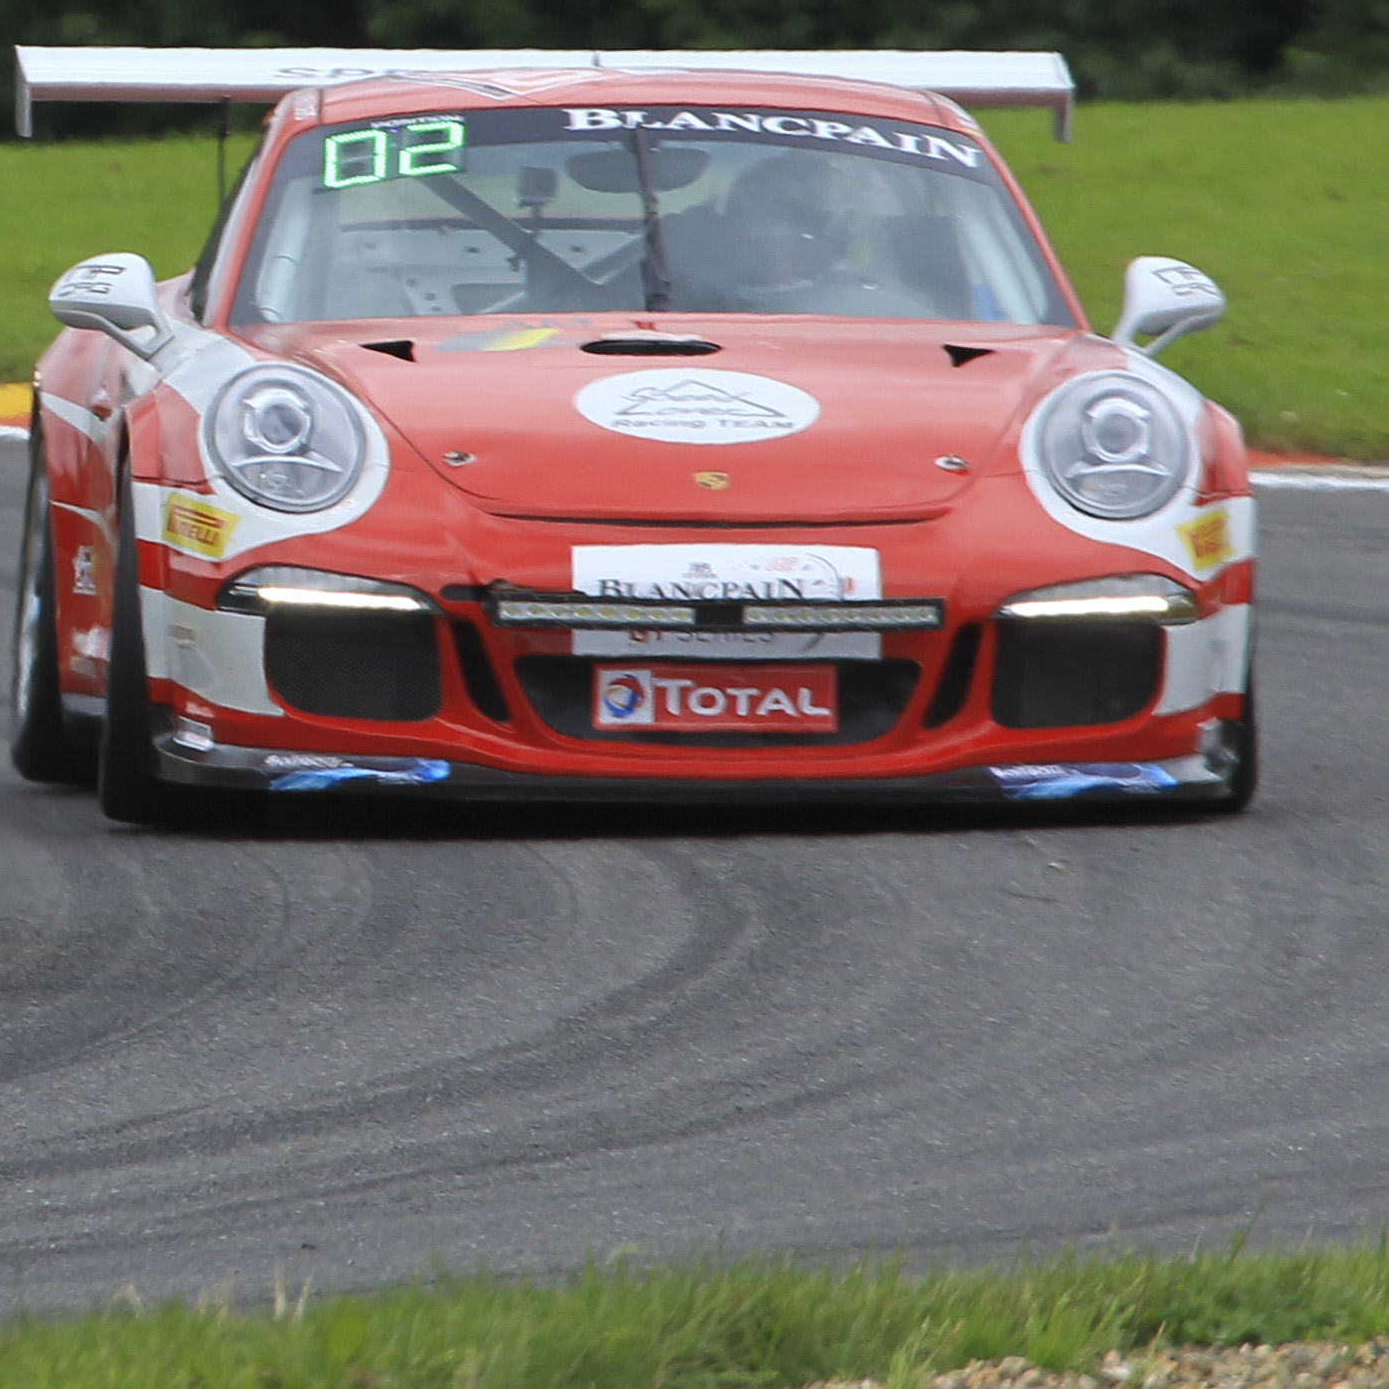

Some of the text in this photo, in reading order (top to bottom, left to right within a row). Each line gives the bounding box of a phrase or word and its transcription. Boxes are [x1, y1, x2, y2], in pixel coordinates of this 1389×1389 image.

[323, 121, 466, 189] 02
[562, 107, 982, 169] BLANCPAIN
[598, 578, 806, 599] BLANCPAIN
[652, 677, 832, 717] TOTAL
